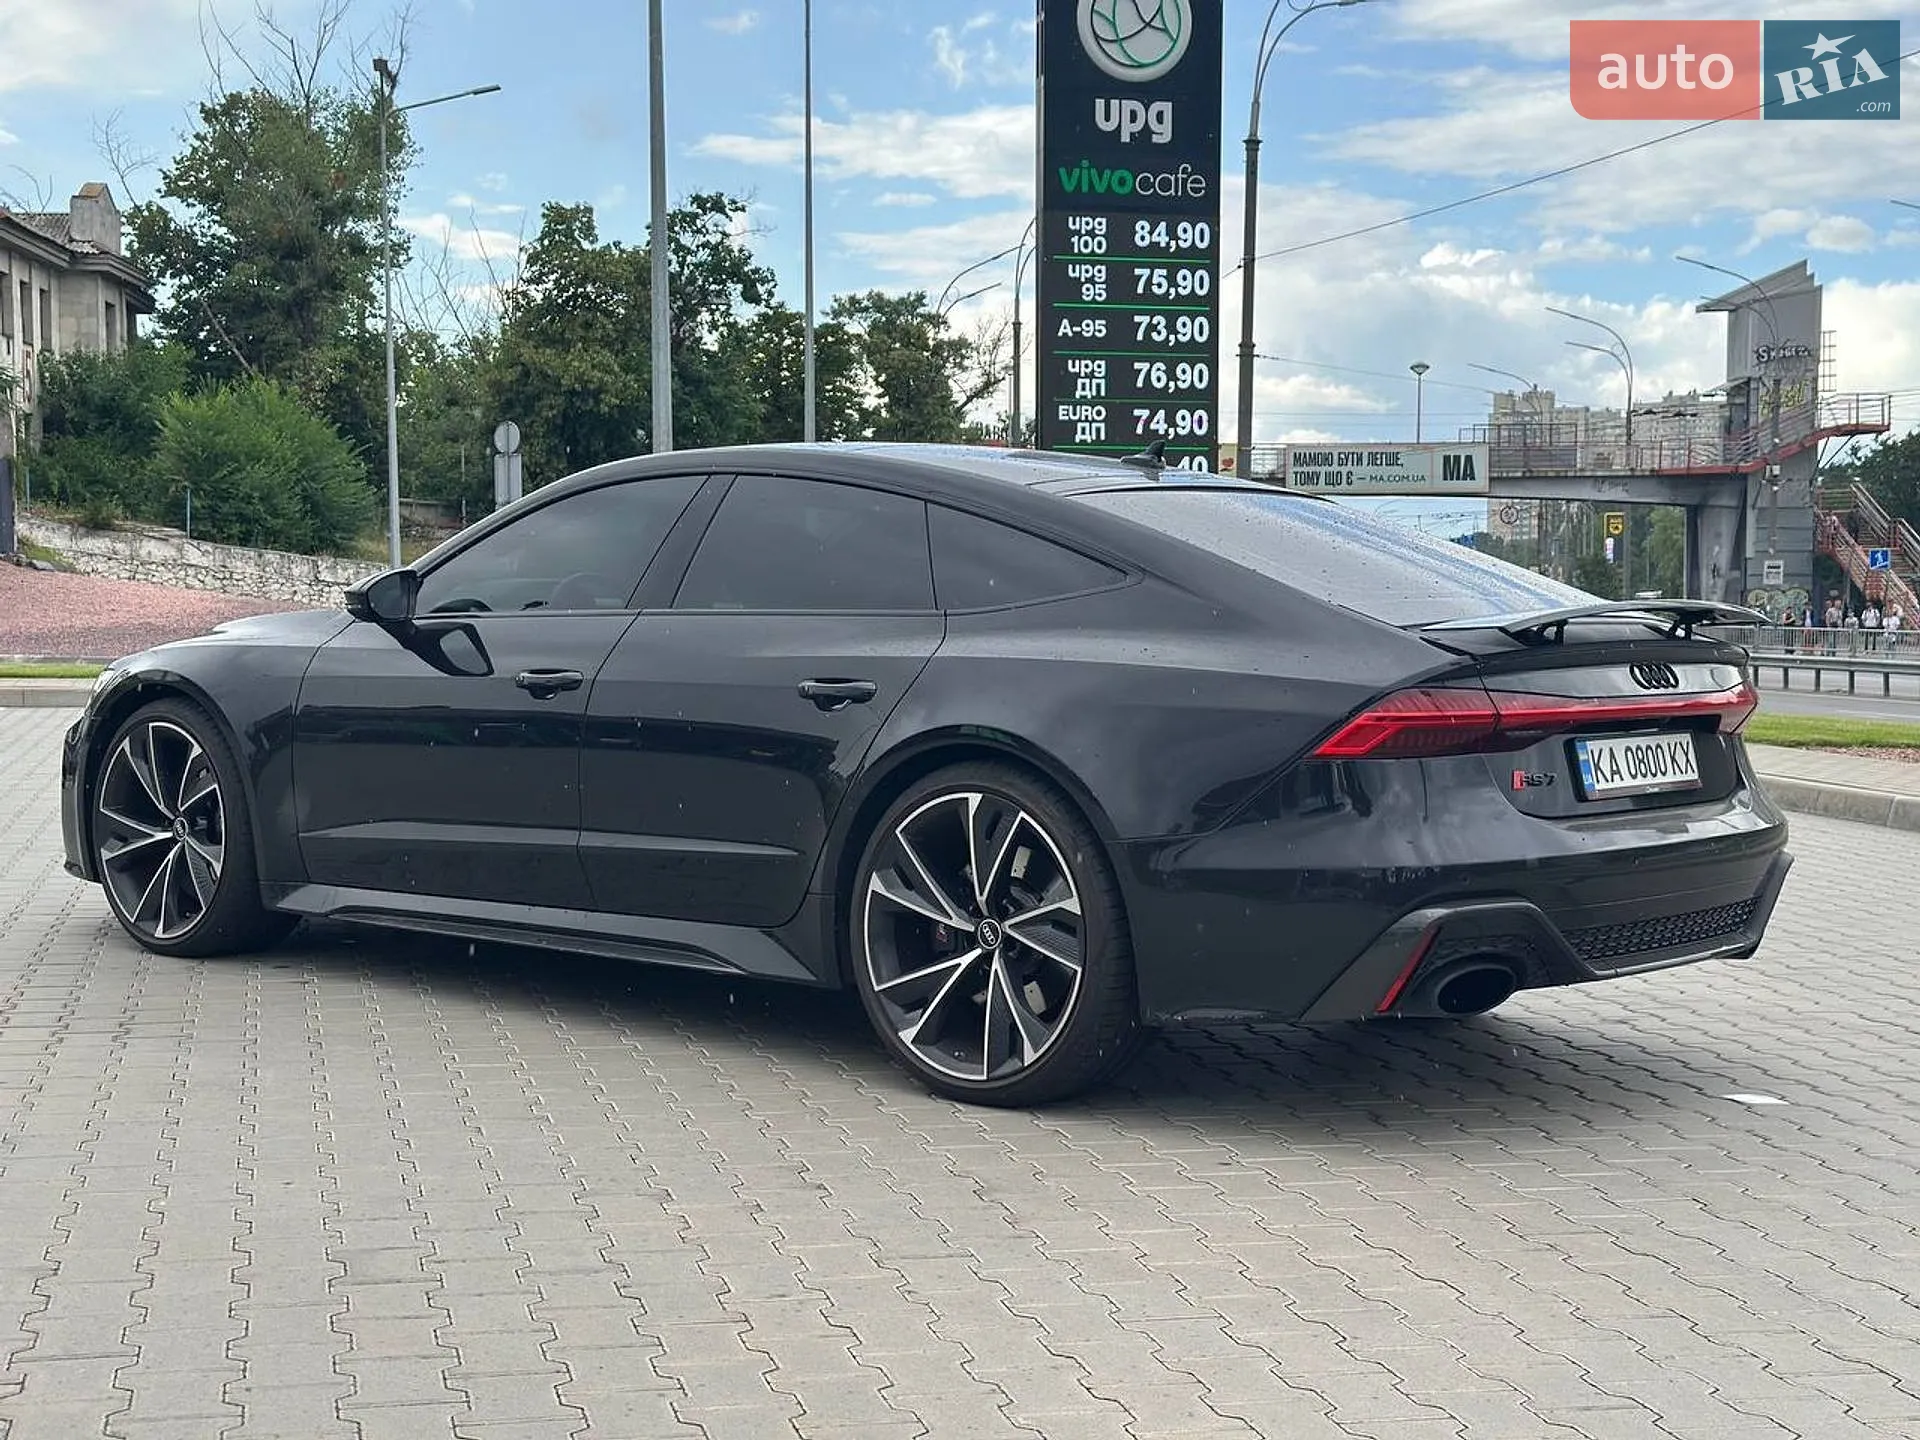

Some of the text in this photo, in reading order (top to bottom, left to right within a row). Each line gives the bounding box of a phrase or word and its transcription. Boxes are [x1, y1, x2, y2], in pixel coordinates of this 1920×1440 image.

[1094, 98, 1173, 144] upg
[1067, 215, 1107, 235] upg
[1070, 235, 1107, 254] 100
[1133, 220, 1211, 252] 84,90
[1067, 263, 1107, 282] upg
[1081, 283, 1107, 301] 95
[1133, 268, 1211, 300] 75,90
[1057, 315, 1210, 346] A-95 73,90
[1067, 359, 1106, 377] upg
[1132, 362, 1209, 393] 76,90
[1075, 378, 1106, 399] ДП
[1058, 405, 1107, 421] EURO
[1075, 422, 1106, 443] ДП
[1132, 409, 1209, 440] 74,90
[1293, 451, 1334, 467] МАМОЮ
[1337, 451, 1363, 467] БУТИ
[1293, 470, 1321, 486] ТОМУ
[1324, 470, 1342, 488] ЩО
[1591, 741, 1696, 784] KA 0800 KX
